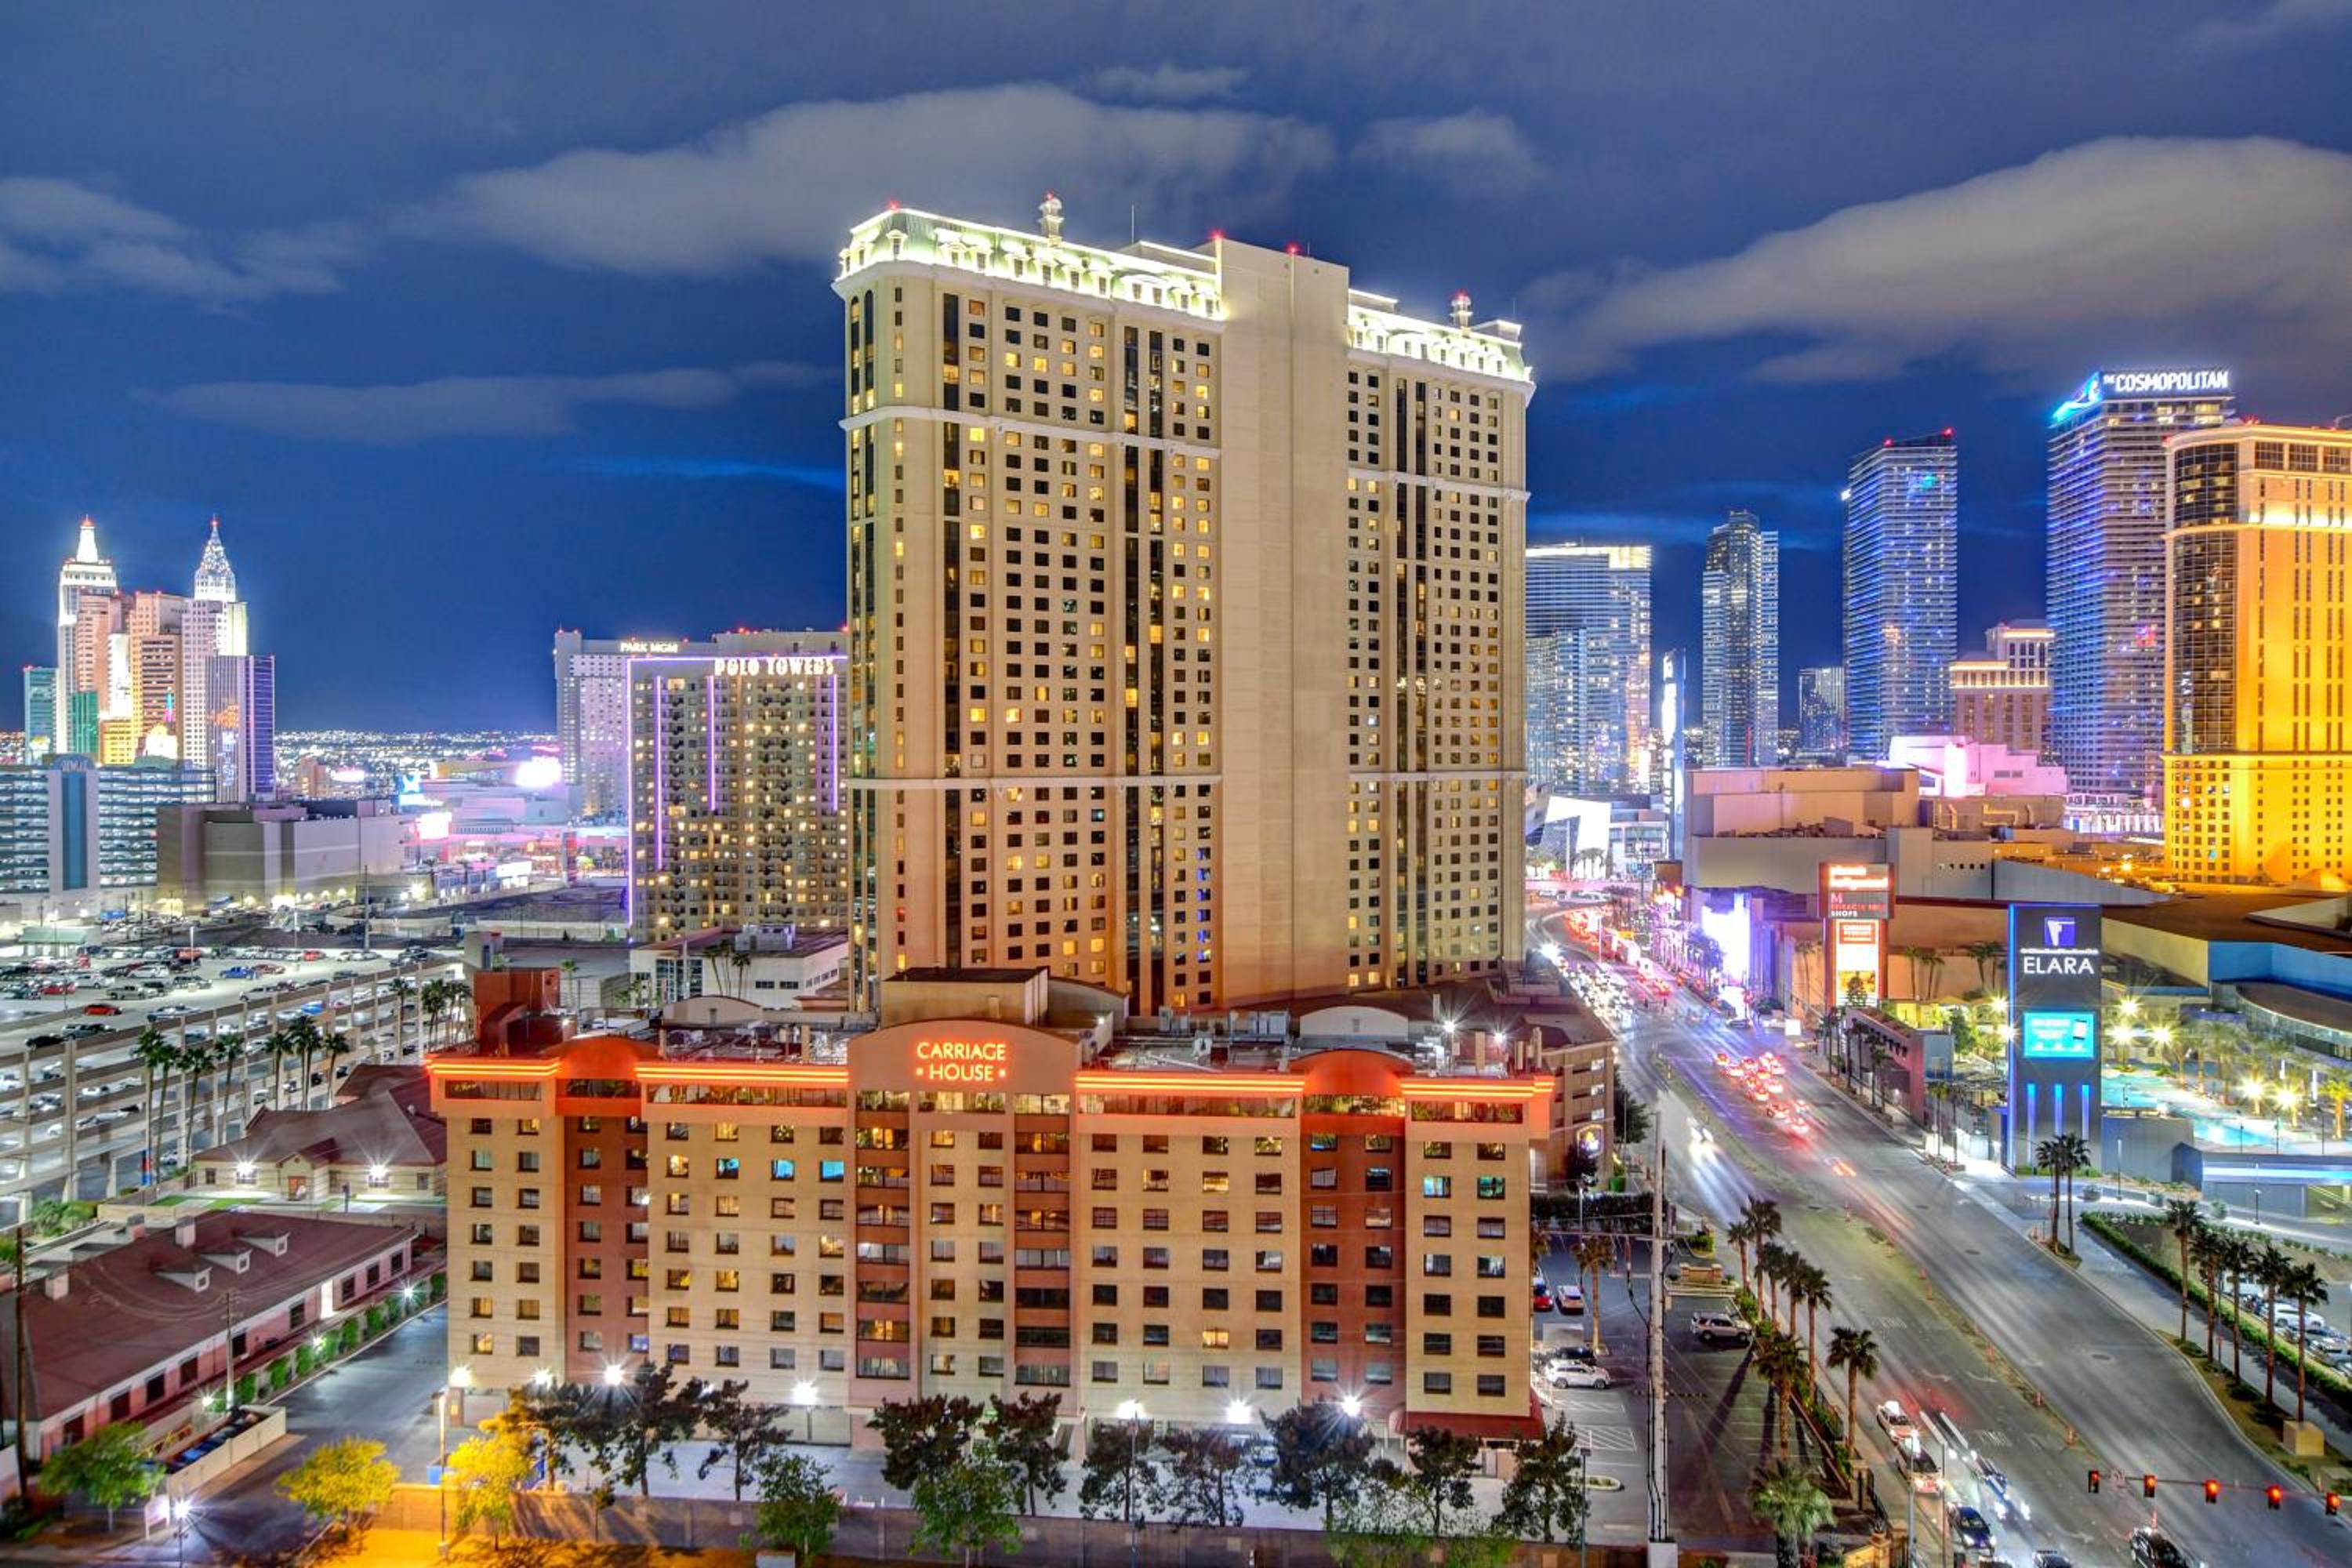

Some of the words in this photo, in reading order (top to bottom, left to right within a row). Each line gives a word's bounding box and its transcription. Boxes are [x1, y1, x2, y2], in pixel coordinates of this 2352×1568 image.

[2103, 374, 2115, 384] THE
[2116, 371, 2228, 391] COSMOPOLITAN
[620, 642, 648, 653] PARK
[650, 642, 678, 654] MGM
[714, 658, 760, 676] POLO
[767, 658, 834, 676] TOWERS
[2024, 956, 2095, 975] ELARA
[916, 1041, 1006, 1061] CARRIAGE
[929, 1063, 994, 1081] HOUSE
